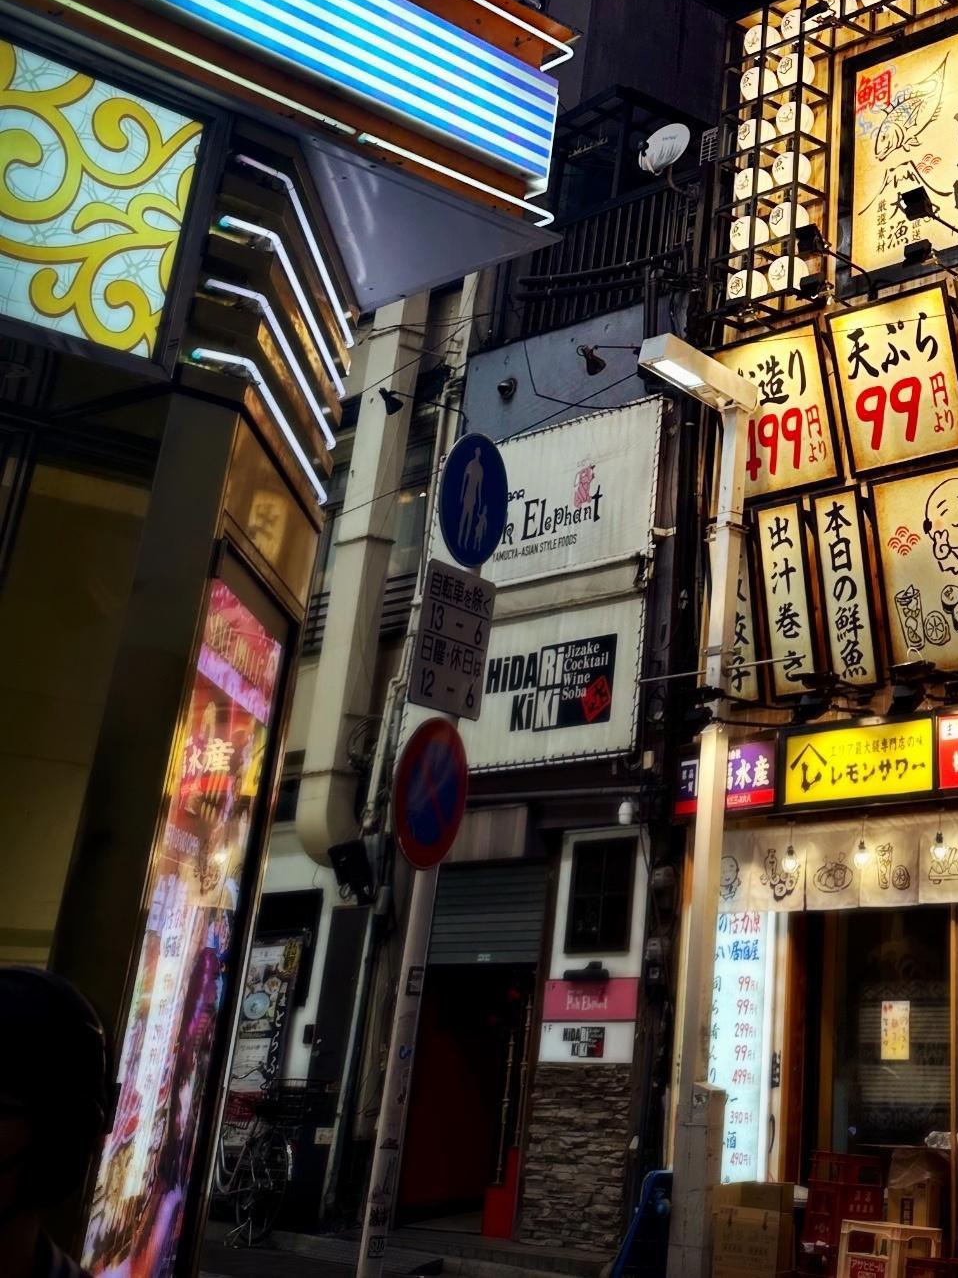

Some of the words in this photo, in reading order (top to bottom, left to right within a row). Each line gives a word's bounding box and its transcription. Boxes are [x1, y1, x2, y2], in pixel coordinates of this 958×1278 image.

[856, 69, 893, 113] 鯛
[876, 199, 888, 253] 厳選素材
[847, 310, 939, 381] 天ぷら
[737, 348, 807, 406] 造り
[855, 376, 923, 451] 99
[539, 539, 557, 554] STYLE
[557, 533, 577, 550] FOODS
[431, 572, 491, 615] 自転車を除く
[767, 516, 807, 683] 出汁巻き
[823, 501, 868, 679] 本日の鮮魚
[563, 651, 610, 673] Cocktail
[564, 641, 600, 660] Jizake
[561, 686, 588, 701] Soba
[562, 672, 591, 686] Wine
[831, 758, 926, 786] レモンサワー
